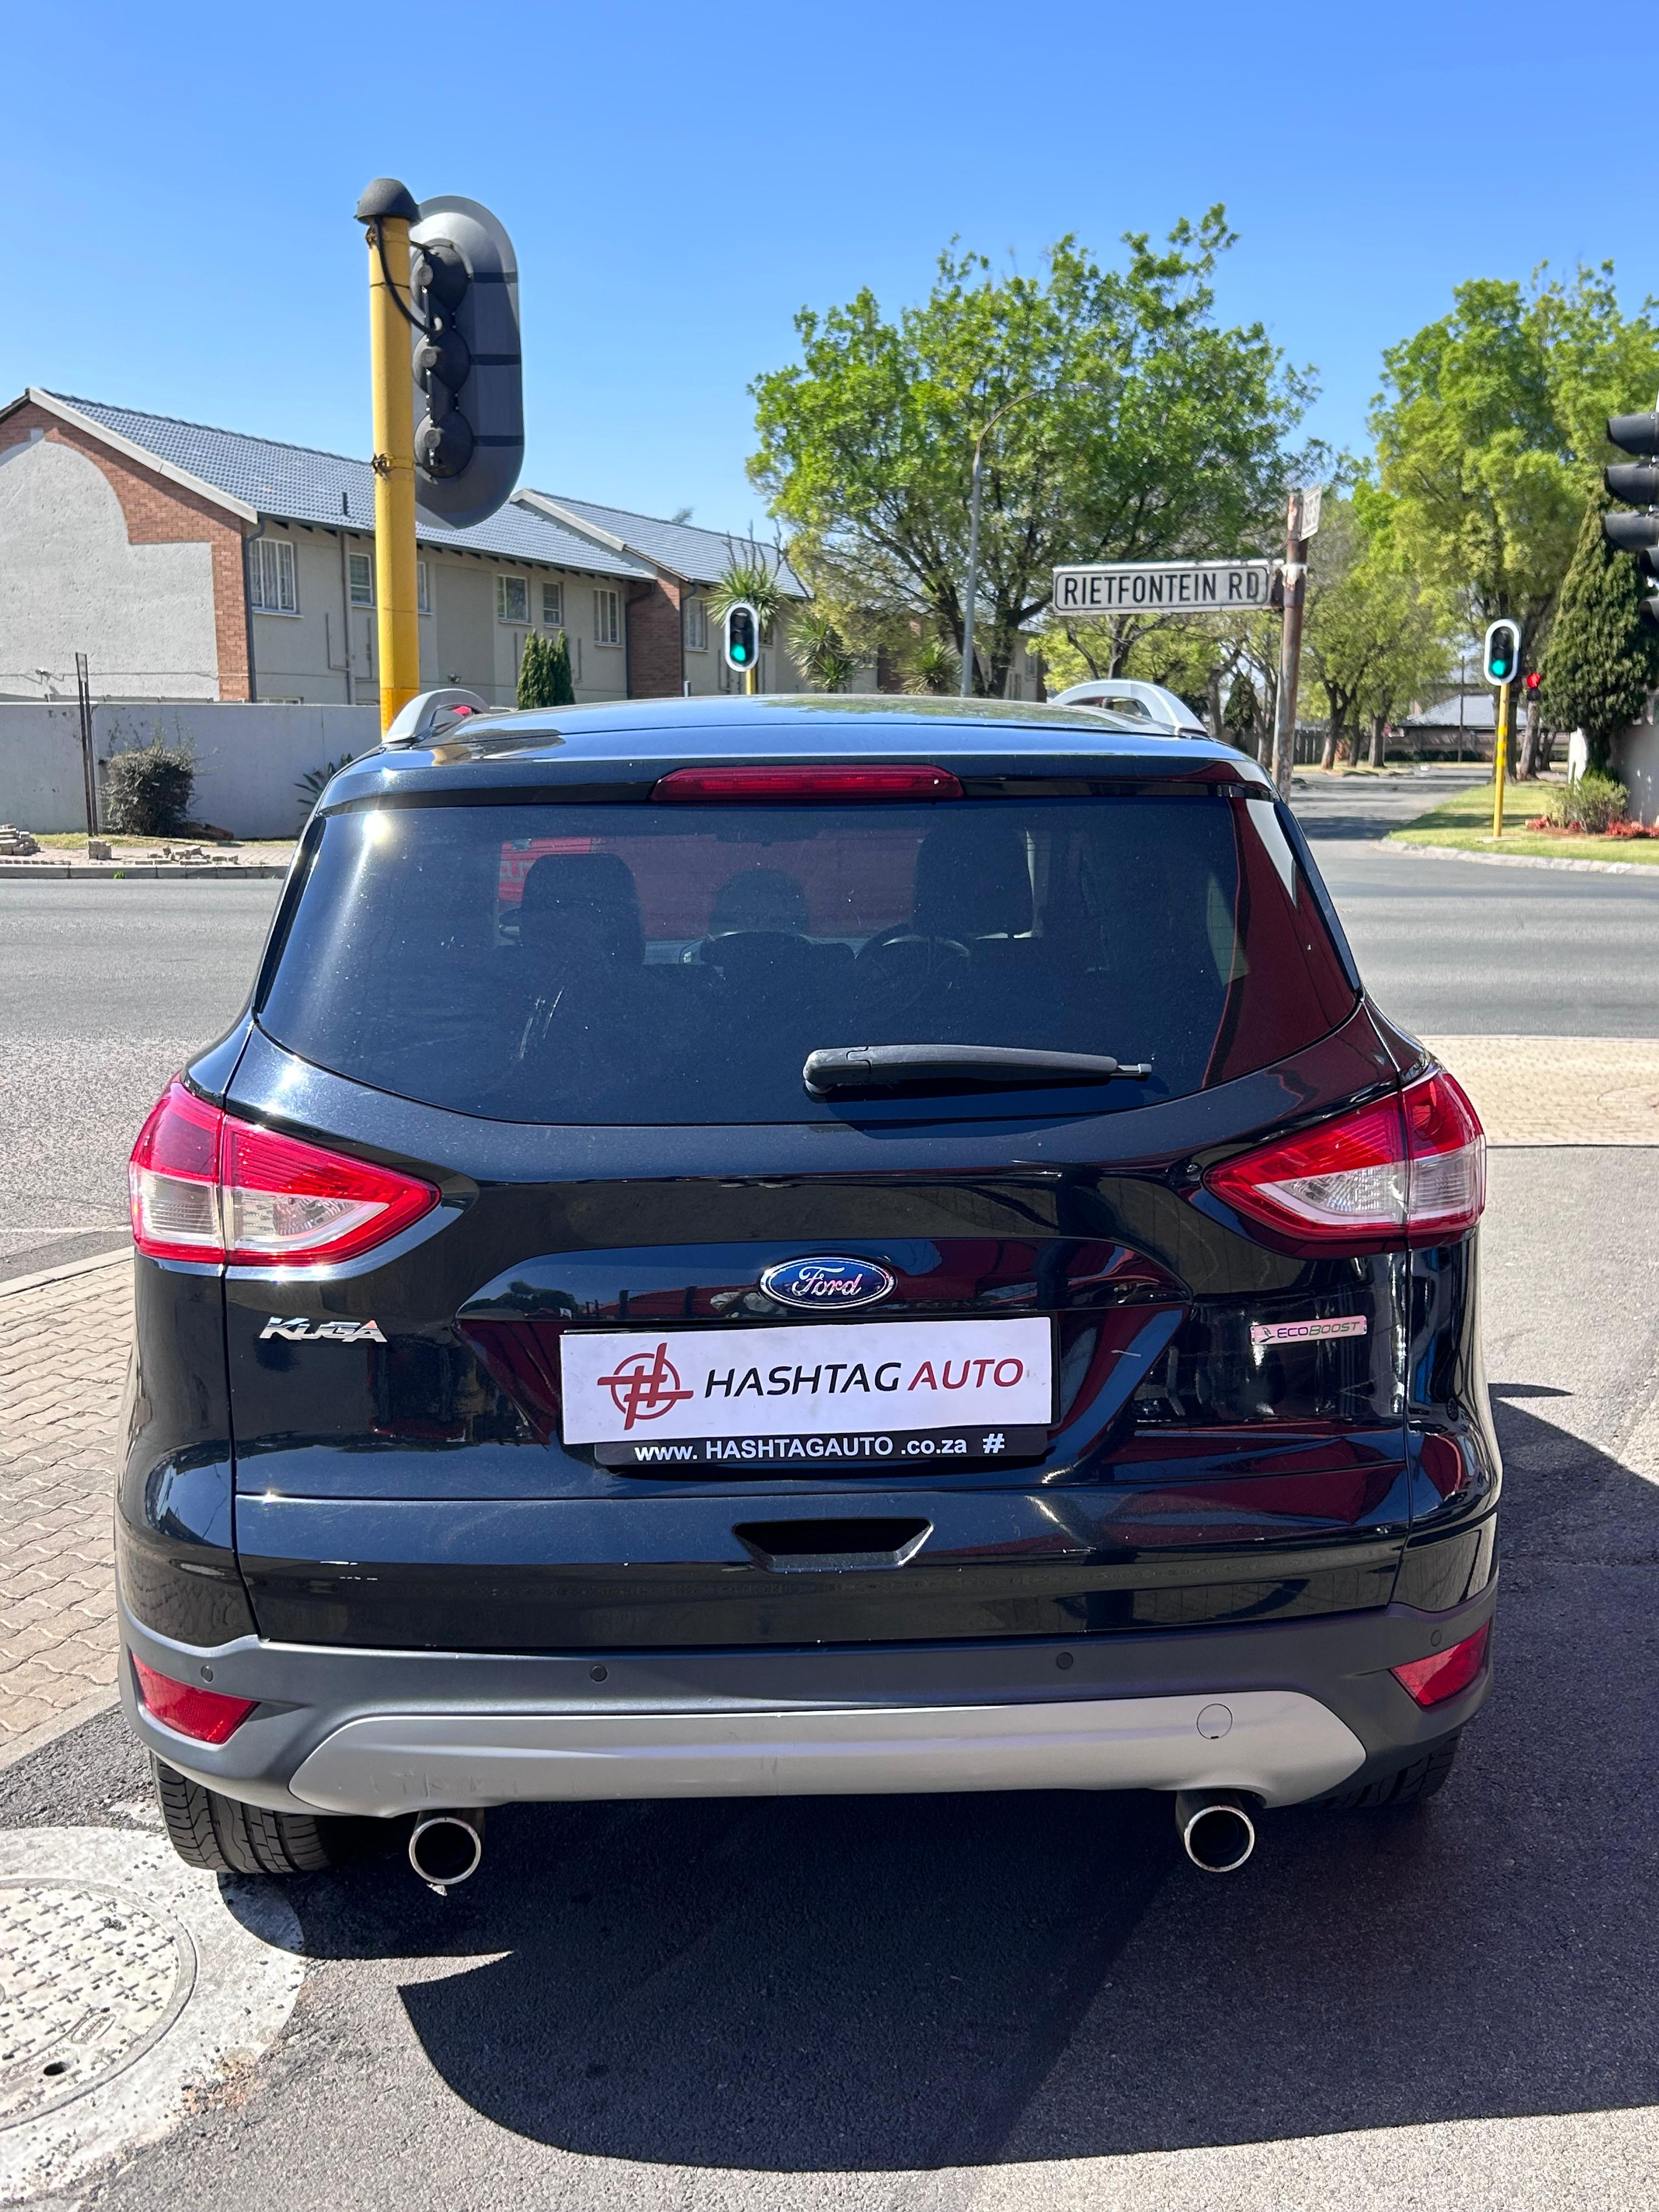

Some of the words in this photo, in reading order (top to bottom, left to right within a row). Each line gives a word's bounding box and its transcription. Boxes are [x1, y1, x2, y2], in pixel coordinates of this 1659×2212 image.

[1064, 572, 1216, 605] RIETFONTEIN
[1229, 571, 1259, 601] RD
[792, 1266, 863, 1296] Ford
[259, 1317, 388, 1342] KUGA
[1277, 1322, 1360, 1339] ECOBOOST
[705, 1362, 903, 1398] HASHTAG
[907, 1357, 1024, 1392] AUTO
[634, 1446, 697, 1461] www.
[706, 1436, 893, 1459] HASHTAGAUTO
[901, 1438, 967, 1455] .co.za
